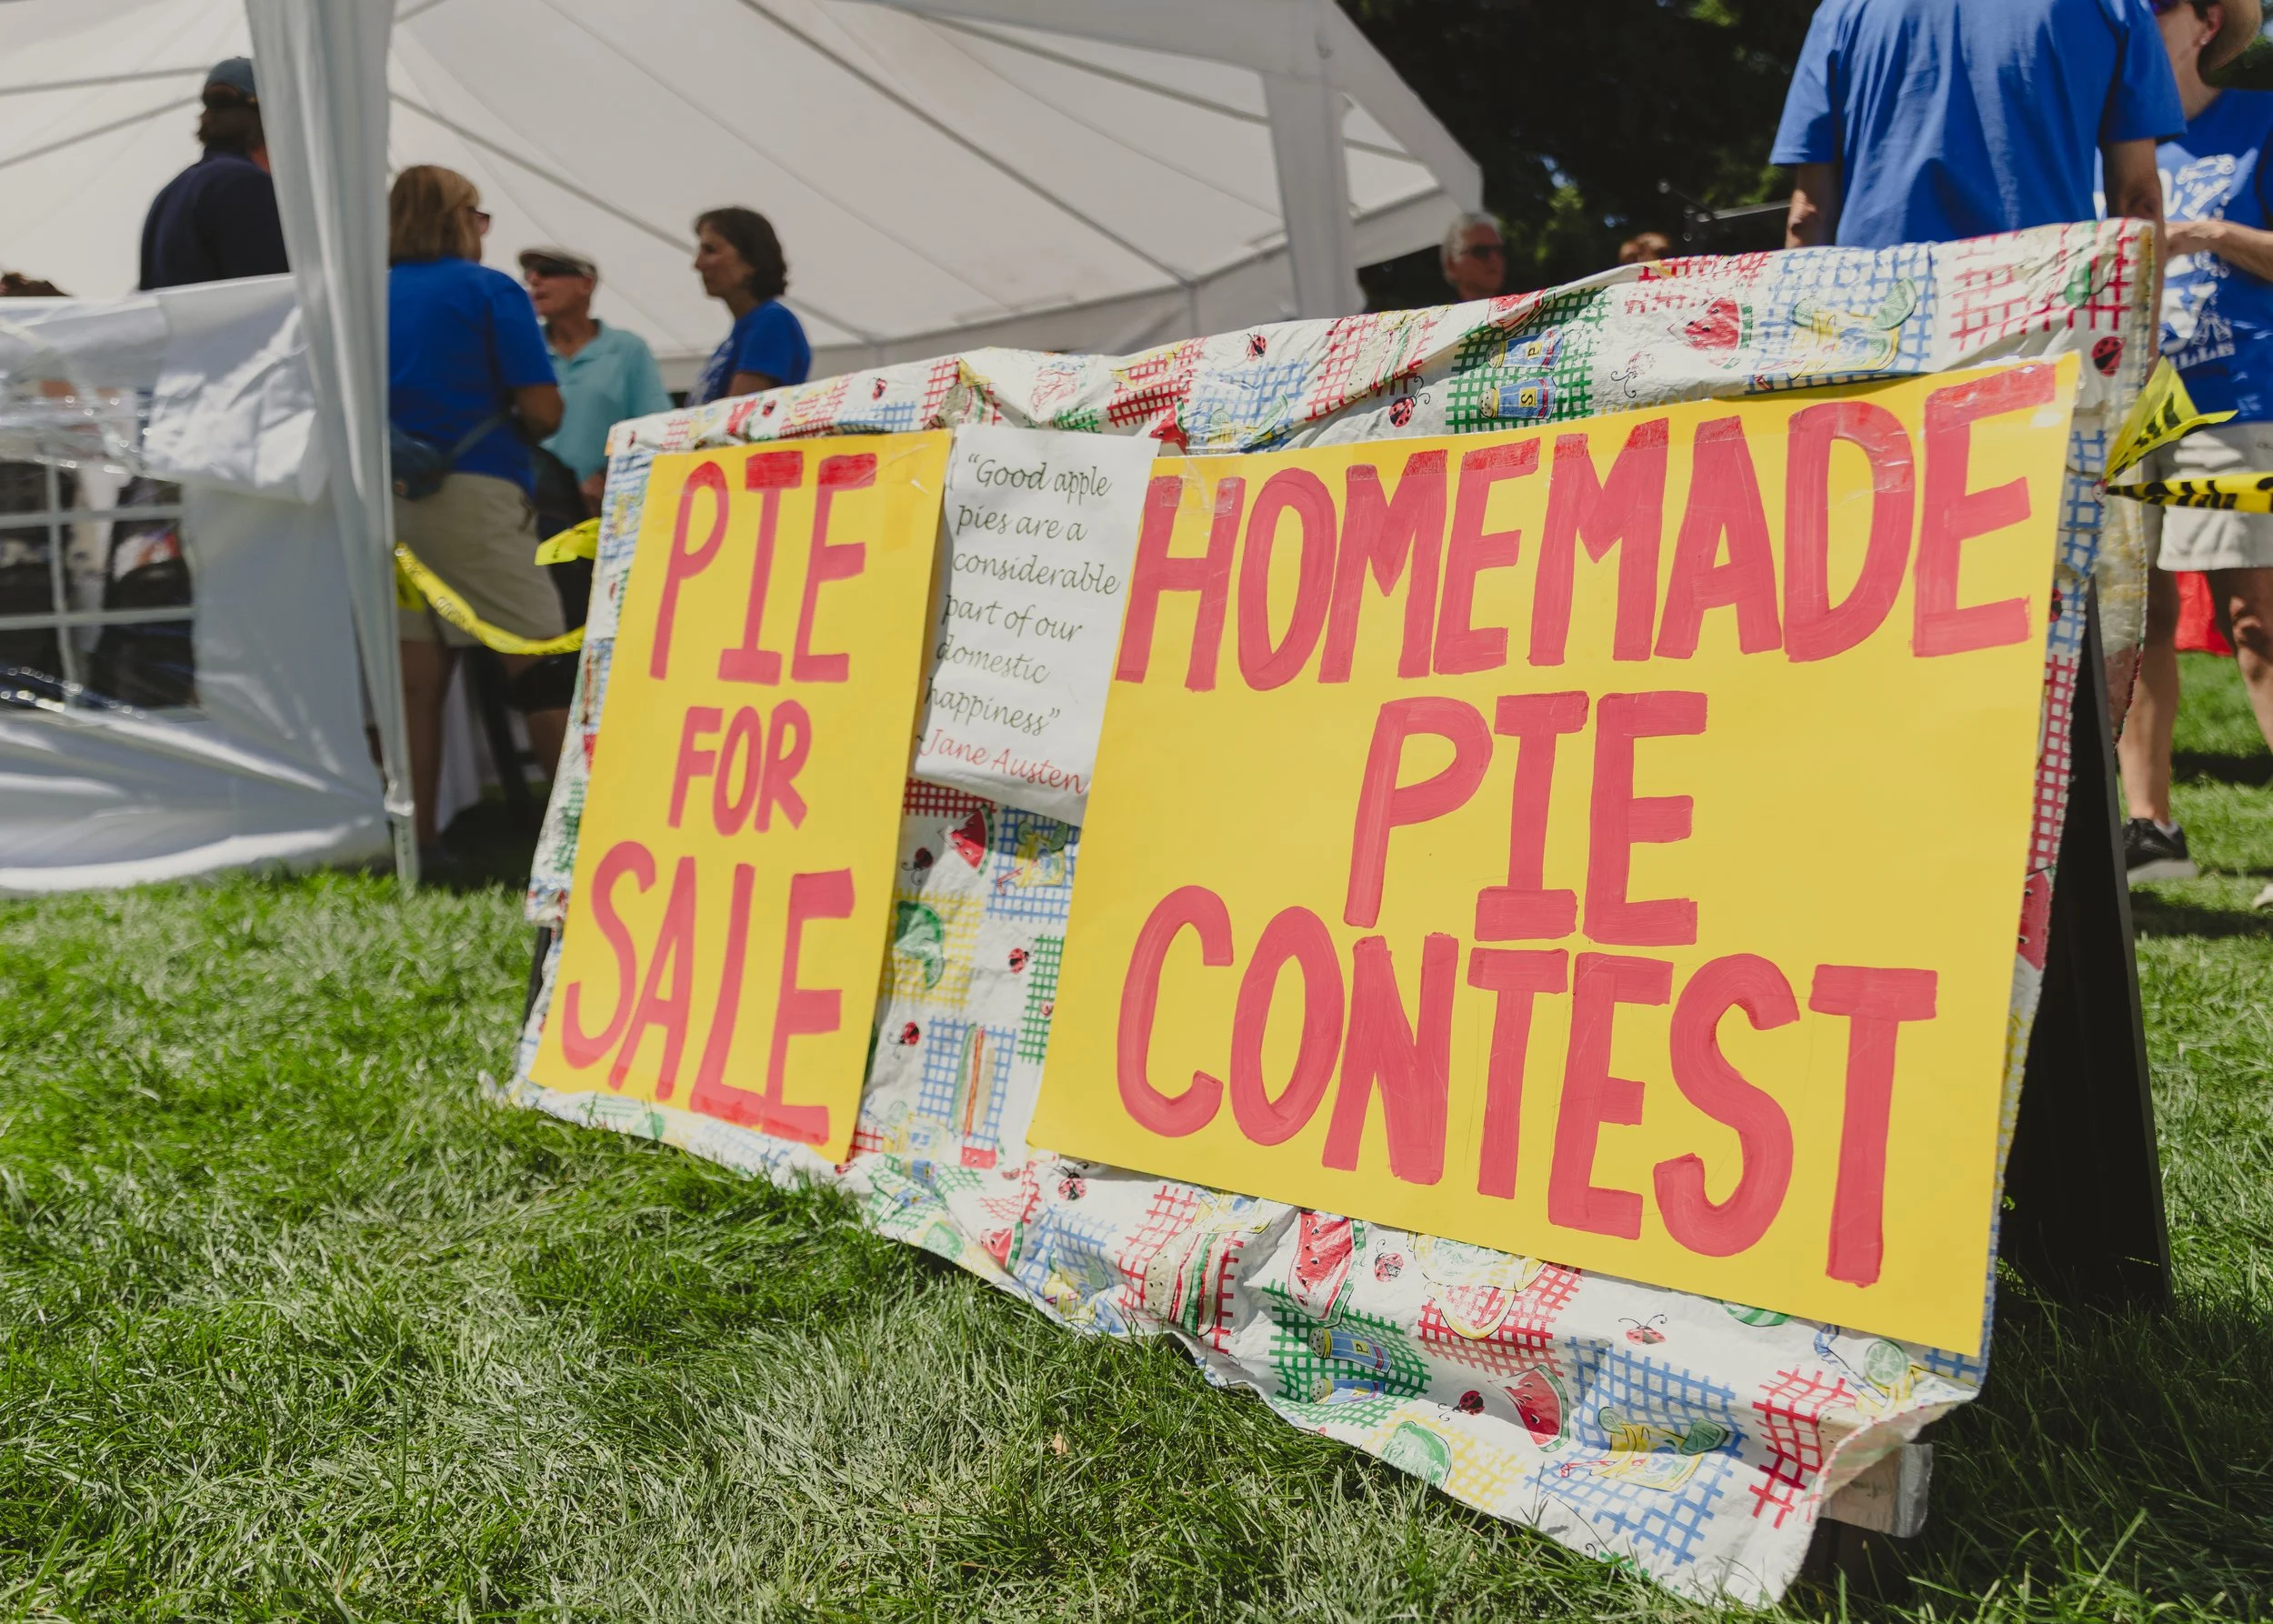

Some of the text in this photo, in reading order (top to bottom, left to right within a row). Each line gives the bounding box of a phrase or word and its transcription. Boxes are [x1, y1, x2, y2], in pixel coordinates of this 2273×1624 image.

[956, 504, 1088, 542] pies are a
[1054, 465, 1113, 506] apple
[1115, 362, 2056, 692] HOMEMADE
[650, 450, 876, 687] PIE
[952, 551, 1122, 596] considerable
[936, 633, 1051, 686] domestic
[940, 593, 1084, 643] part of our
[668, 699, 812, 837] FOR
[991, 748, 1092, 796] Austen
[1344, 689, 1707, 947] PIE
[562, 841, 856, 1146] SALE
[1116, 884, 1938, 1288] CONTEST
